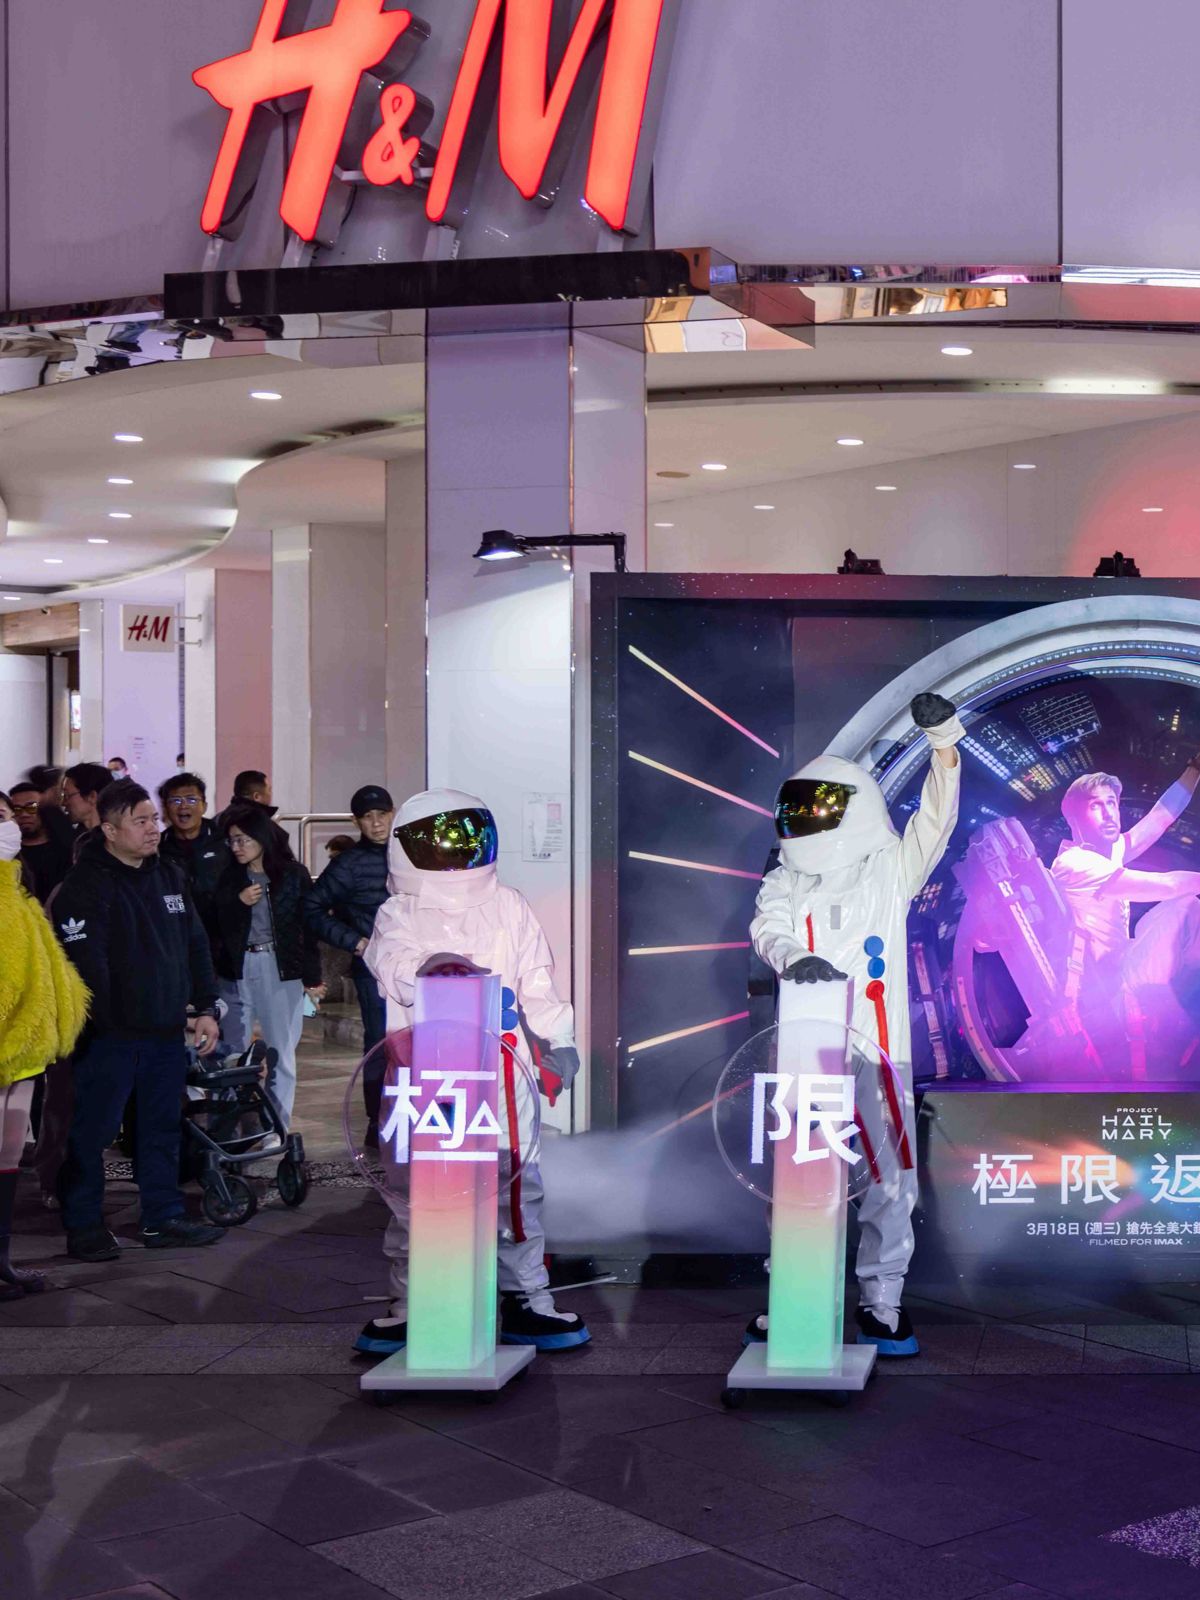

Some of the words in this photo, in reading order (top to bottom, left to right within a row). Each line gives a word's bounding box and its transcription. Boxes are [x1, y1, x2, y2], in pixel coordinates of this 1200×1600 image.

[193, 0, 665, 241] H&M
[127, 614, 171, 643] H&M
[64, 933, 87, 943] adidas
[380, 1066, 503, 1165] 極
[751, 1073, 863, 1166] 限
[1102, 1115, 1172, 1126] HAIL
[1102, 1128, 1172, 1140] MARY
[1089, 1238, 1128, 1246] FILMED
[1154, 1238, 1183, 1246] IMAX
